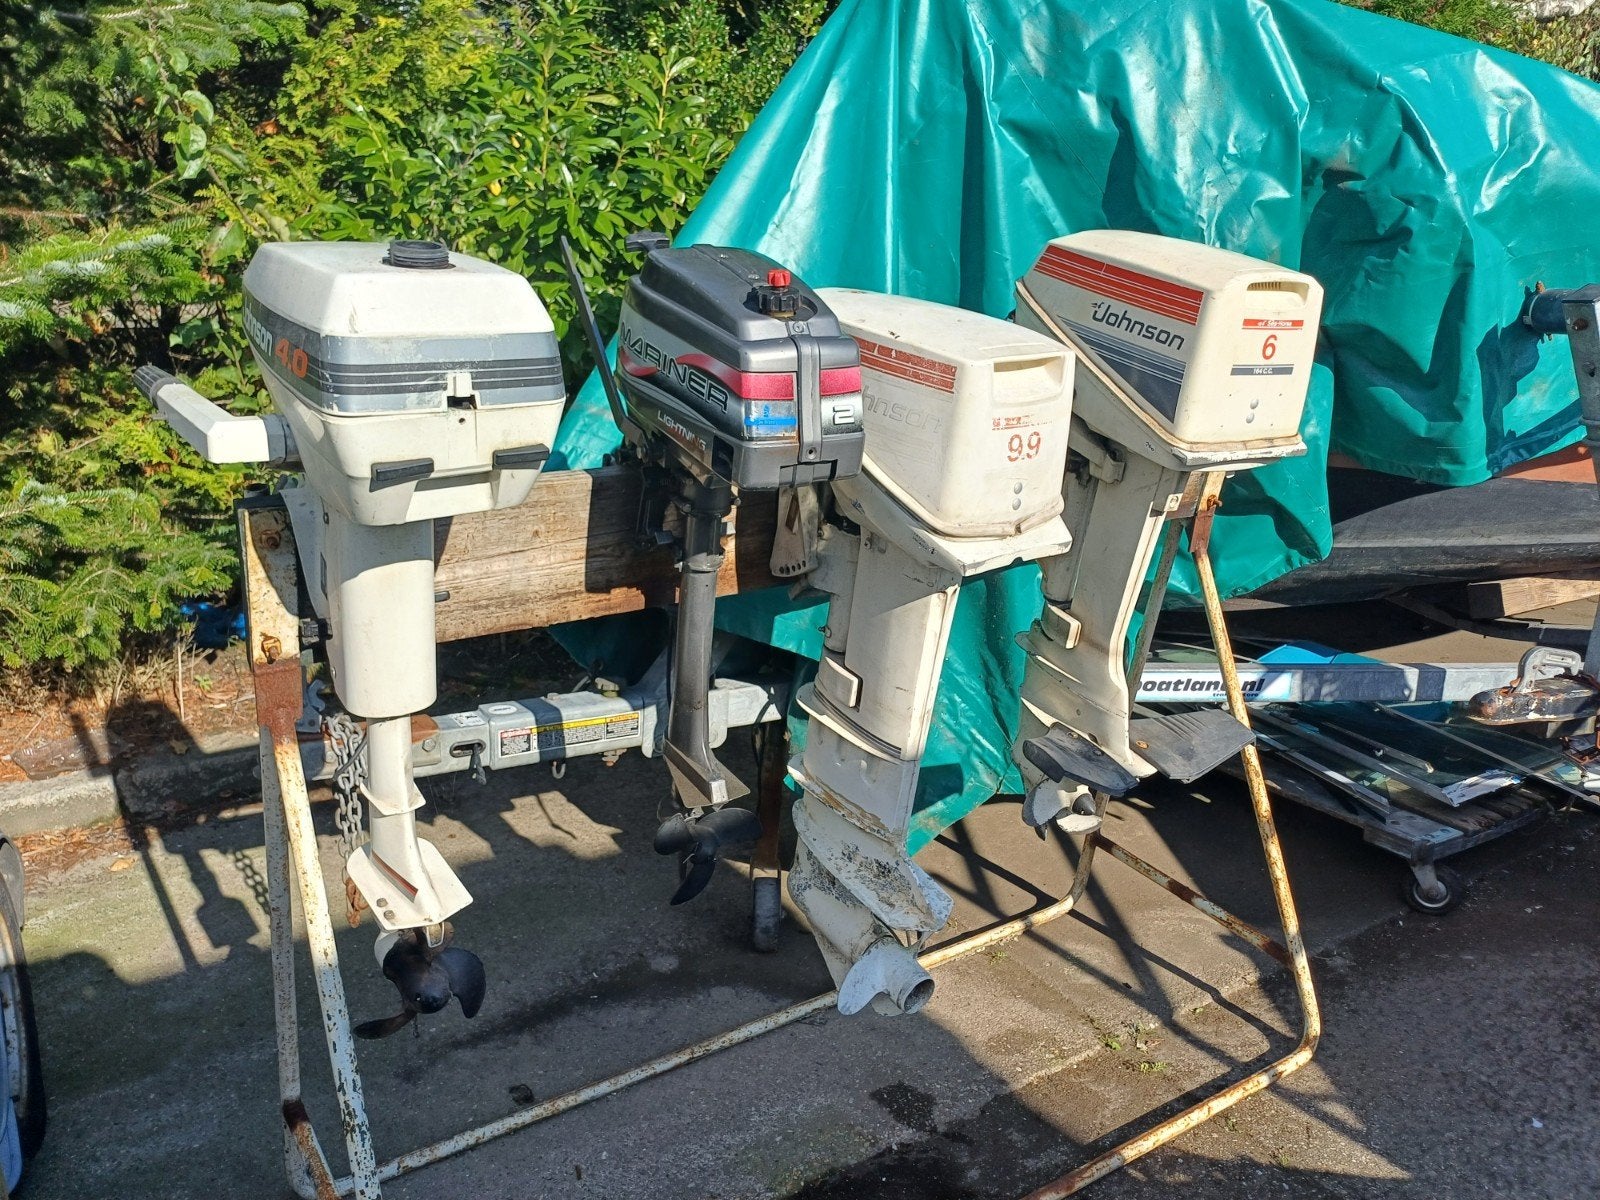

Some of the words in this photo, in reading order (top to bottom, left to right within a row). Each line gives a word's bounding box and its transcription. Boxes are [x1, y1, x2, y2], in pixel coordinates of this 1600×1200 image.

[1091, 302, 1185, 350] Johnson
[1262, 334, 1277, 360] 6
[275, 337, 309, 378] 4.0
[620, 320, 729, 414] MARINER
[657, 409, 706, 451] LIGHTNING
[833, 404, 855, 425] 2
[862, 385, 943, 433] hnson
